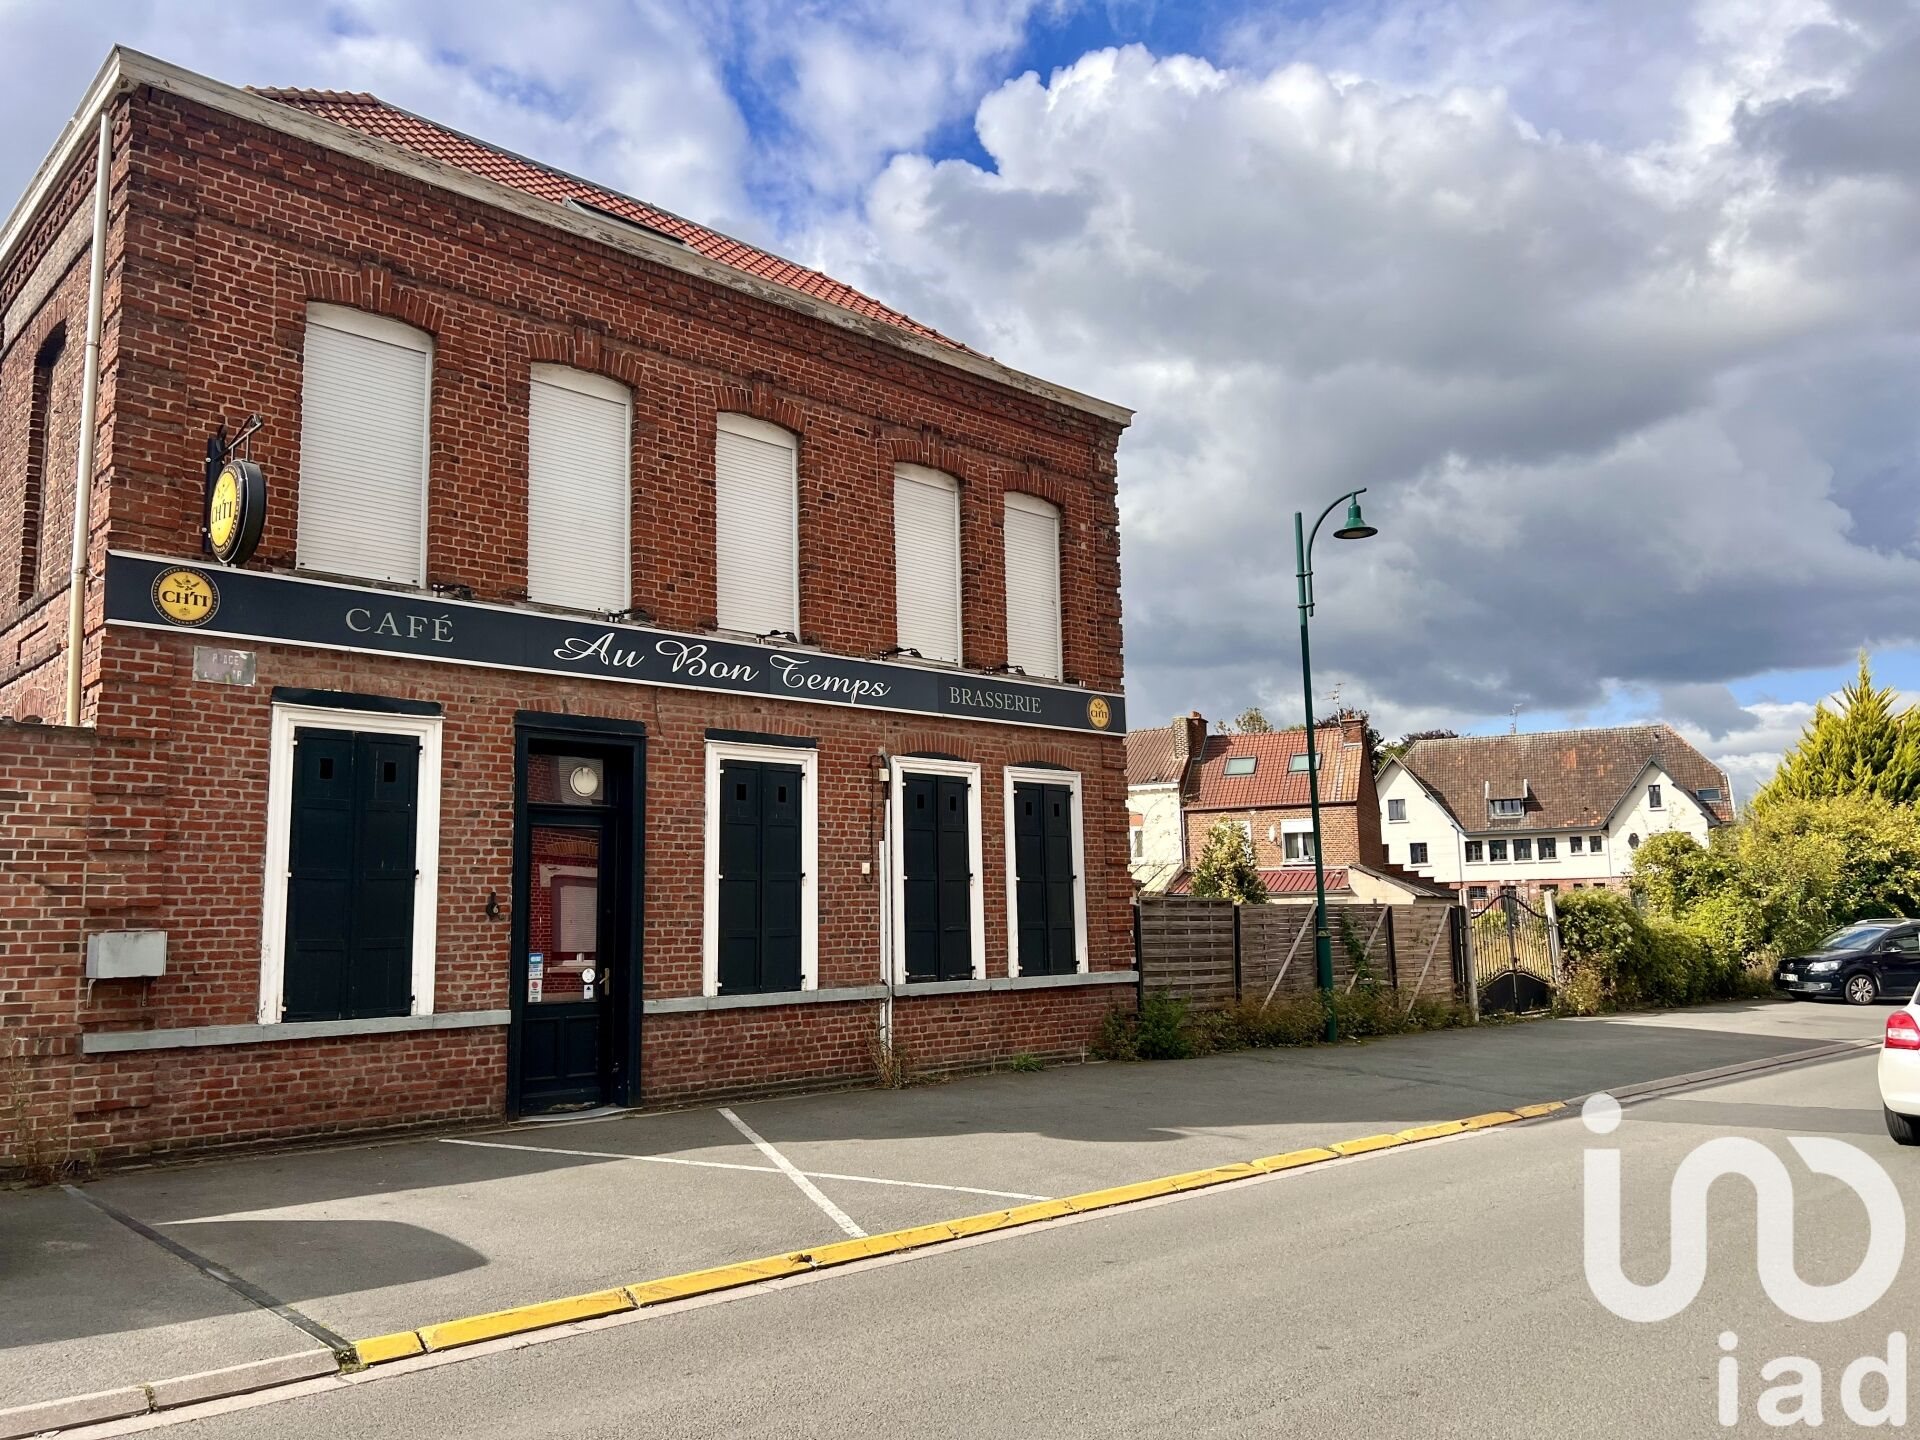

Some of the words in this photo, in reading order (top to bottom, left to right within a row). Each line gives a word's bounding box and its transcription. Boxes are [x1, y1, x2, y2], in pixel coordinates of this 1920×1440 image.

[211, 501, 232, 524] CH'TI
[162, 590, 208, 607] CH'TI
[345, 607, 455, 643] CAFÉ
[212, 653, 240, 666] PACE
[553, 632, 645, 668] Au
[655, 639, 759, 683] Bon
[768, 653, 892, 704] Temps
[949, 686, 1042, 714] BRASSERIE
[493, 904, 499, 913] 6
